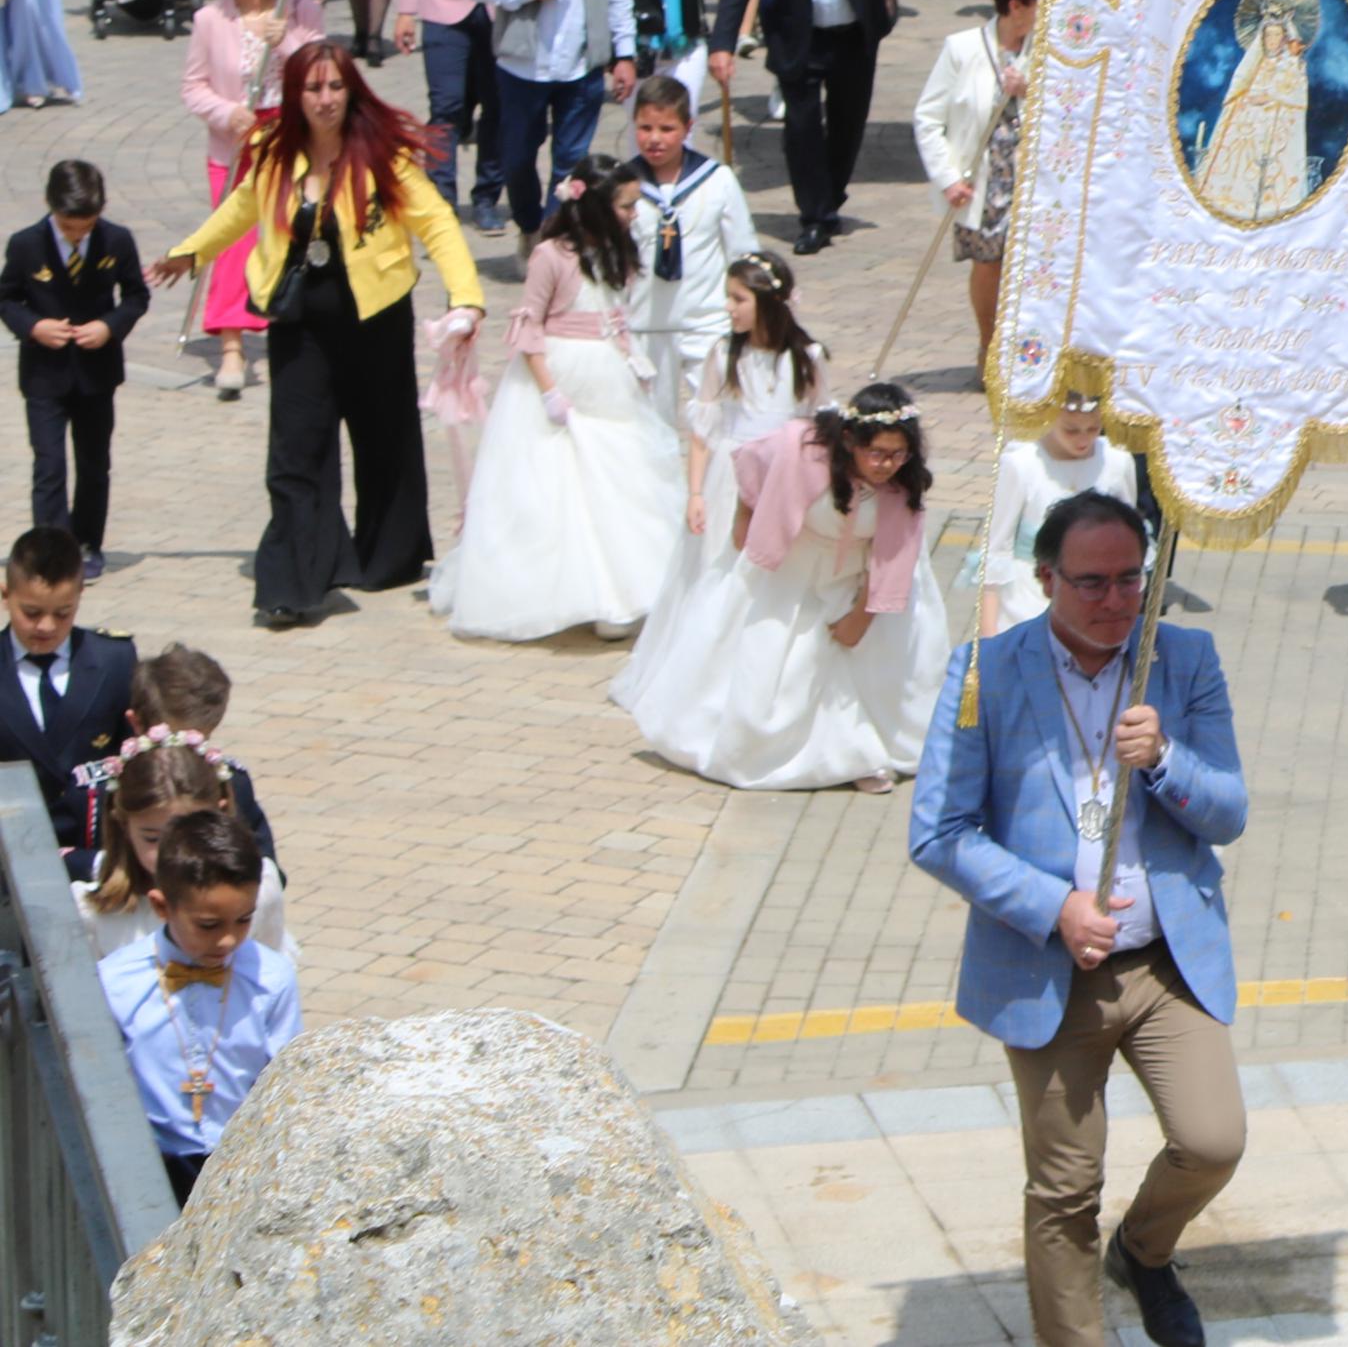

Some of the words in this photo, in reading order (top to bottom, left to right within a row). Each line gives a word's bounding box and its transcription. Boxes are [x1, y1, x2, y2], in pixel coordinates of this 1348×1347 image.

[1229, 284, 1272, 310] DE
[1172, 322, 1314, 352] CERRATO
[1118, 363, 1158, 389] IV
